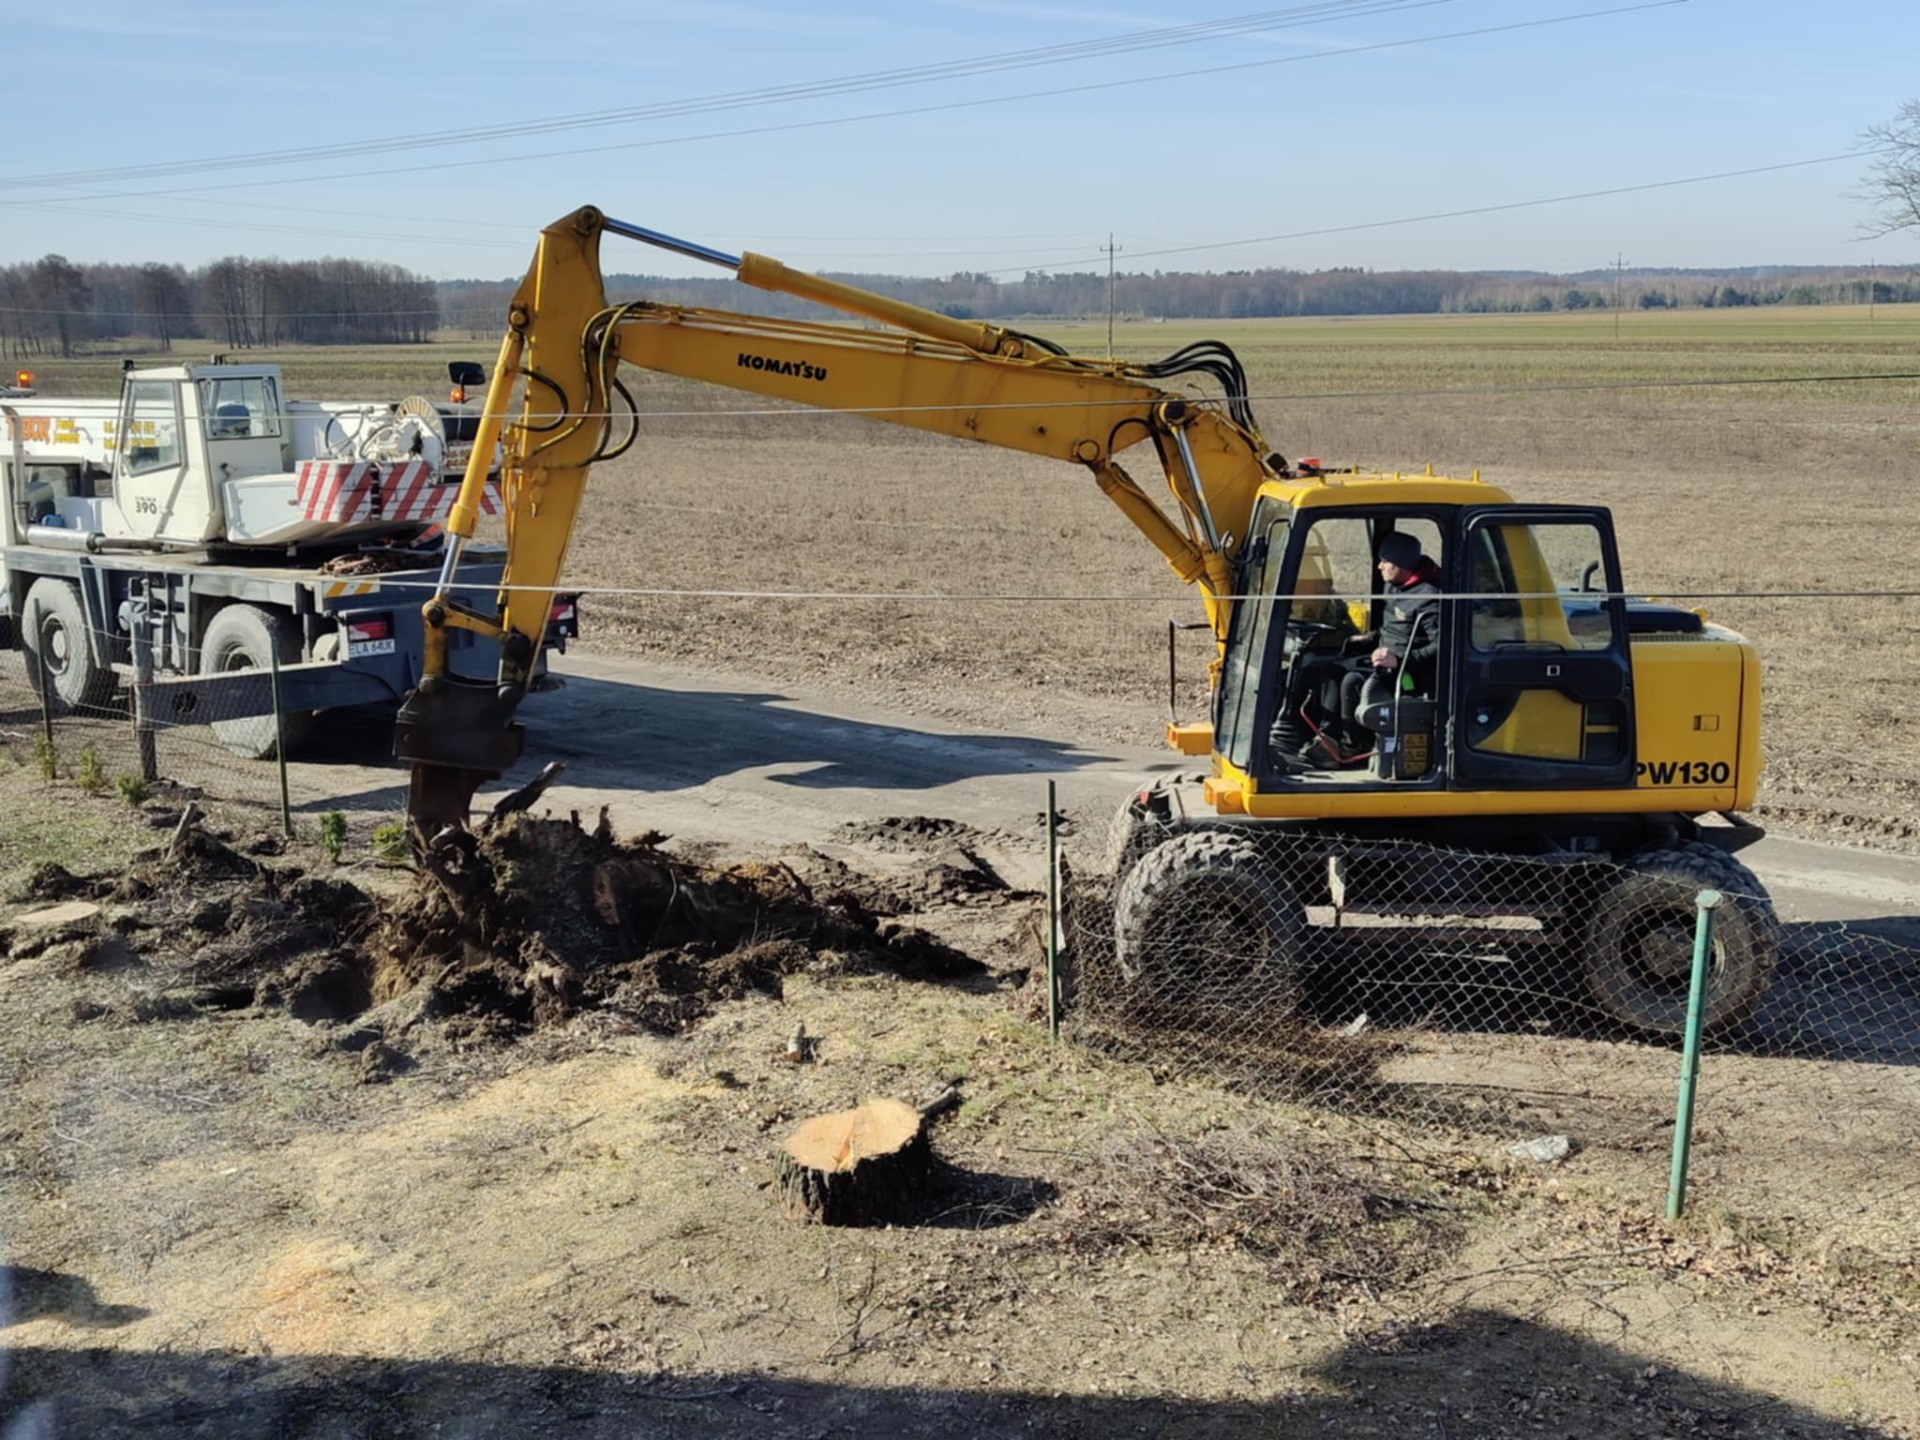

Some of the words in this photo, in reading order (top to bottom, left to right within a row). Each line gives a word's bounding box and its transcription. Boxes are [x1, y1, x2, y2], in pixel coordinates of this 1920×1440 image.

[737, 353, 828, 381] KOMATSU
[135, 500, 158, 514] 390
[1636, 761, 1731, 785] PW130
